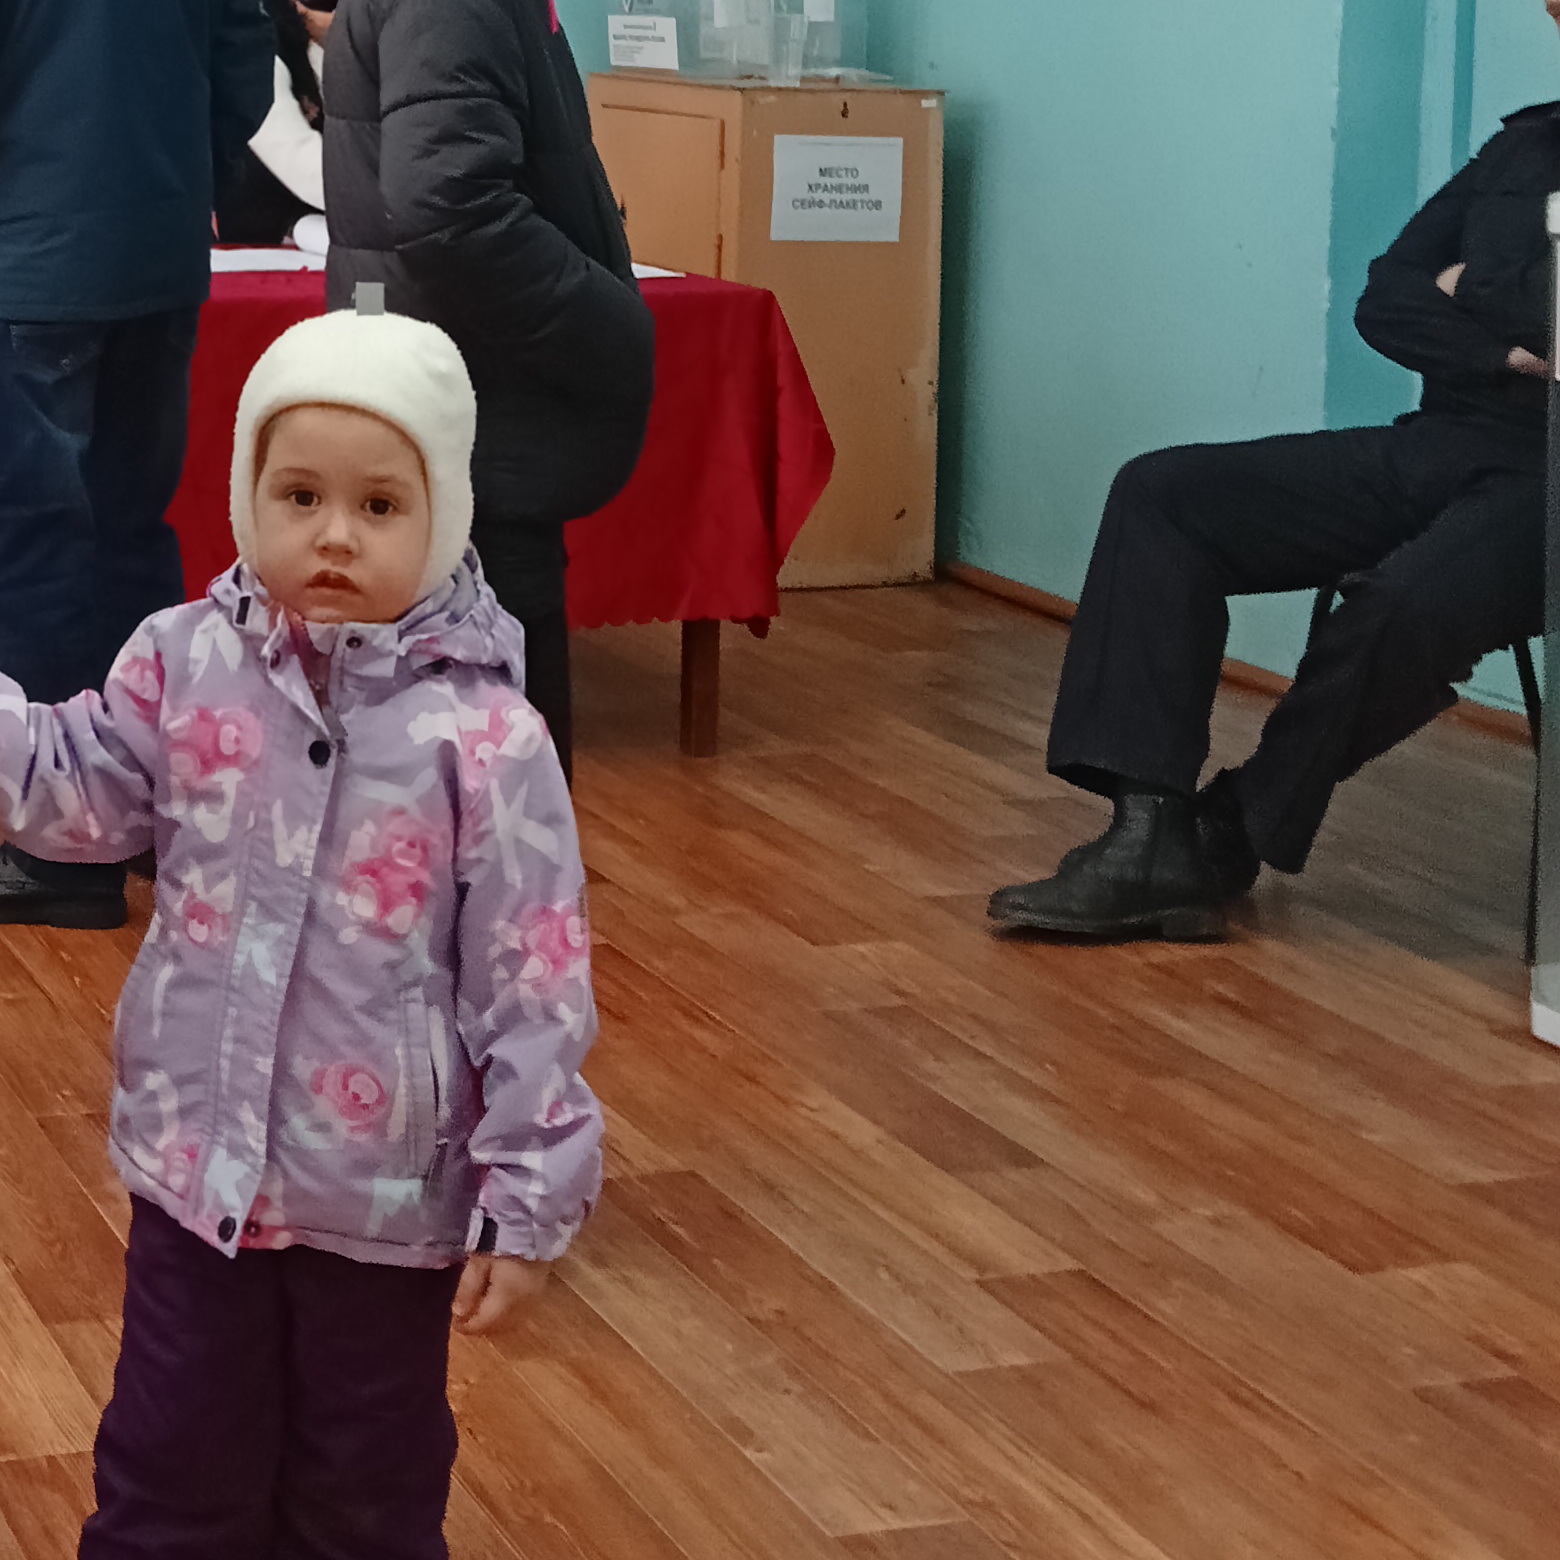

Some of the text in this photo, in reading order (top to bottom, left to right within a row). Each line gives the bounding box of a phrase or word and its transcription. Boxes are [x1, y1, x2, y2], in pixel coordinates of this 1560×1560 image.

[818, 167, 860, 179] МЕСТО
[807, 183, 870, 195] ХРАНЕНИЯ
[791, 197, 883, 211] СЕЙФ-ПАКЕТОВ
